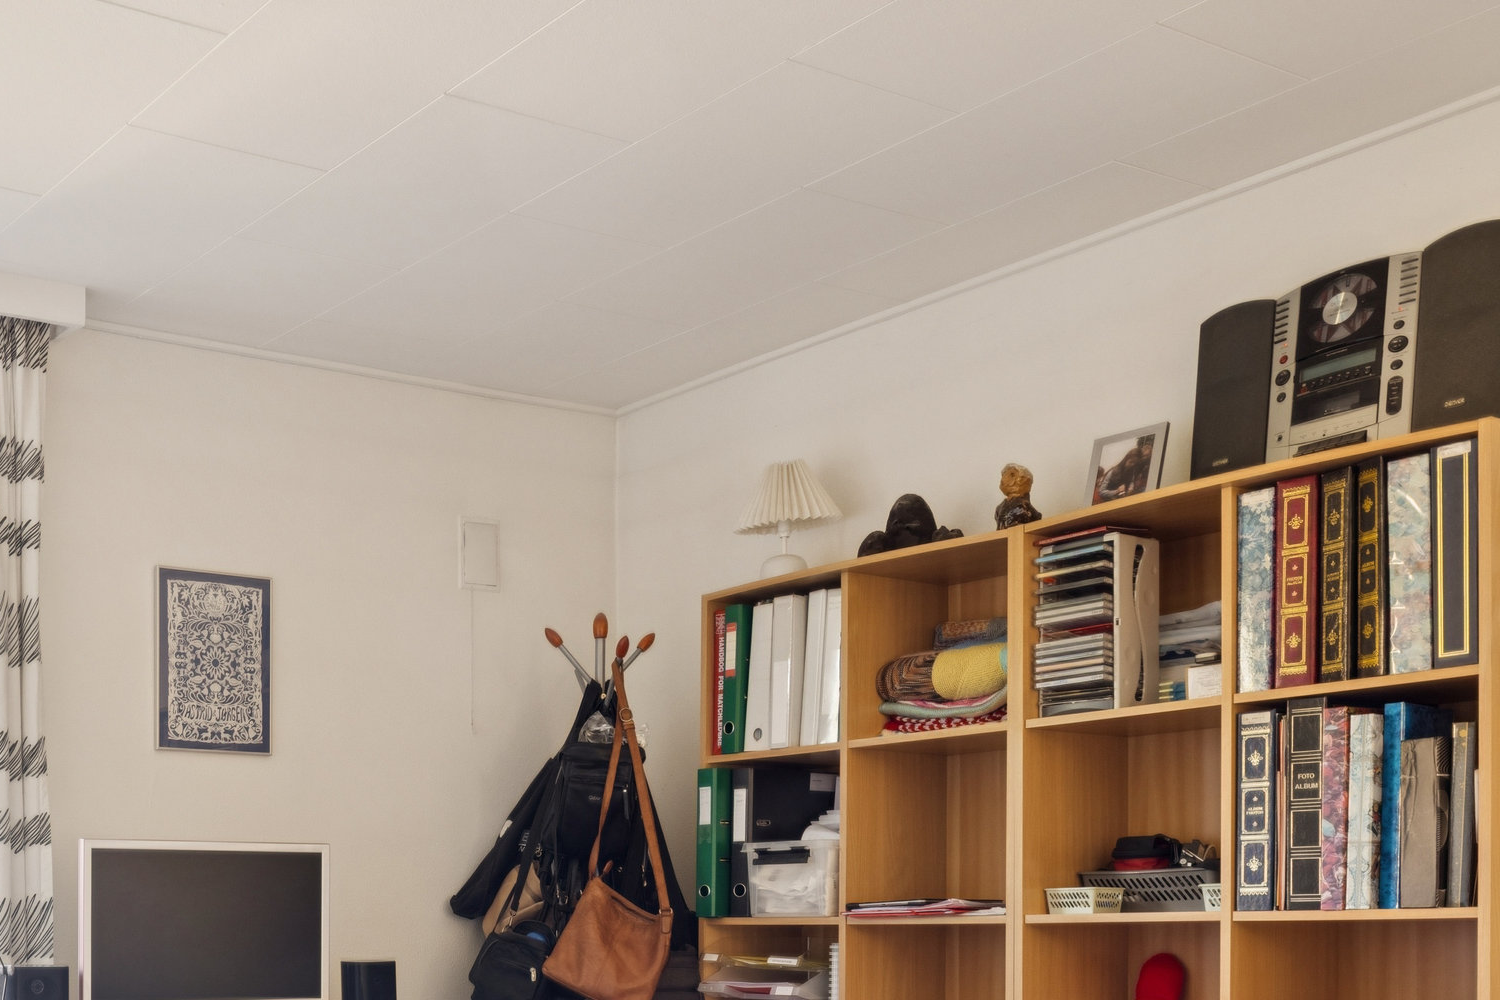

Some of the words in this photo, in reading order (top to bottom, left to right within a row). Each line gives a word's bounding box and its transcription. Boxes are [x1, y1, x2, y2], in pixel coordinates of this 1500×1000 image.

[184, 704, 212, 721] ASTRID
[216, 705, 247, 723] JØRGEN
[1297, 772, 1315, 780] FOTO
[1294, 782, 1318, 790] ALBUM
